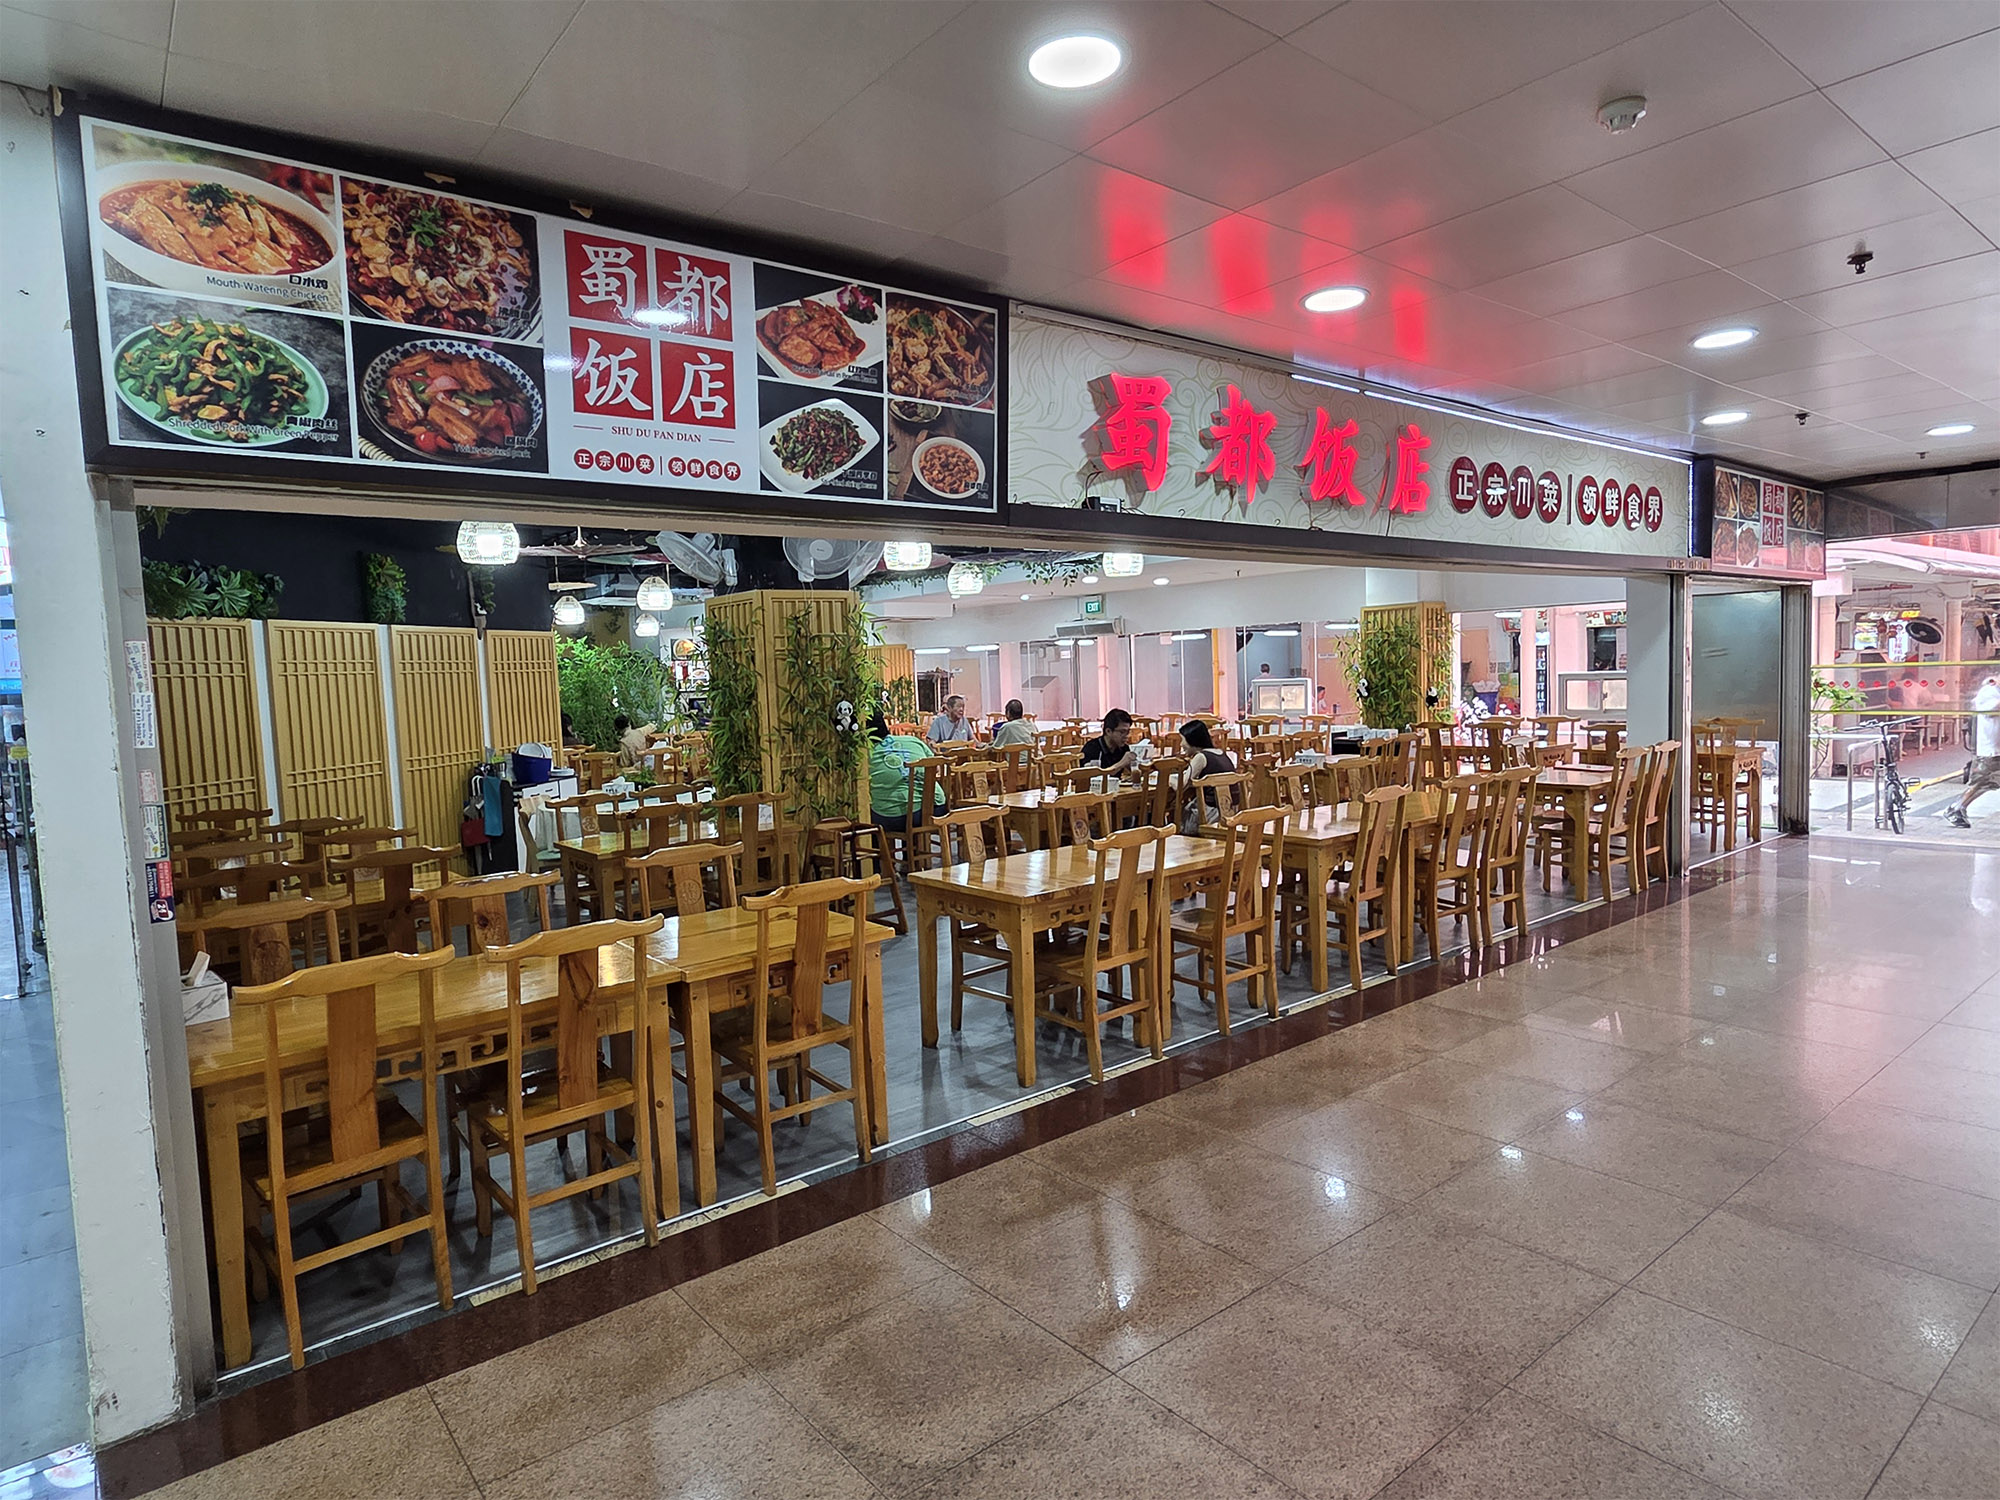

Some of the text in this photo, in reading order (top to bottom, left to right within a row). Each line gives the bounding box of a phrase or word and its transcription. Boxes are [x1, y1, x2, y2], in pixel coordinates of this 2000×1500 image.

[289, 274, 329, 290] 口水鸡
[290, 288, 329, 302] Chicken
[579, 243, 729, 335] 蜀都
[574, 337, 730, 420] 饭店
[168, 417, 220, 431] Shredded
[273, 427, 302, 438] Green
[303, 430, 339, 443] Pepper
[611, 426, 633, 437] SHU
[636, 429, 651, 438] DU
[676, 433, 702, 443] DIAN
[1102, 372, 1432, 515] 蜀都饭店
[577, 452, 738, 478] 正宗川菜 领鲜食界
[1455, 468, 1662, 524] 正宗川菜 领鲜食界
